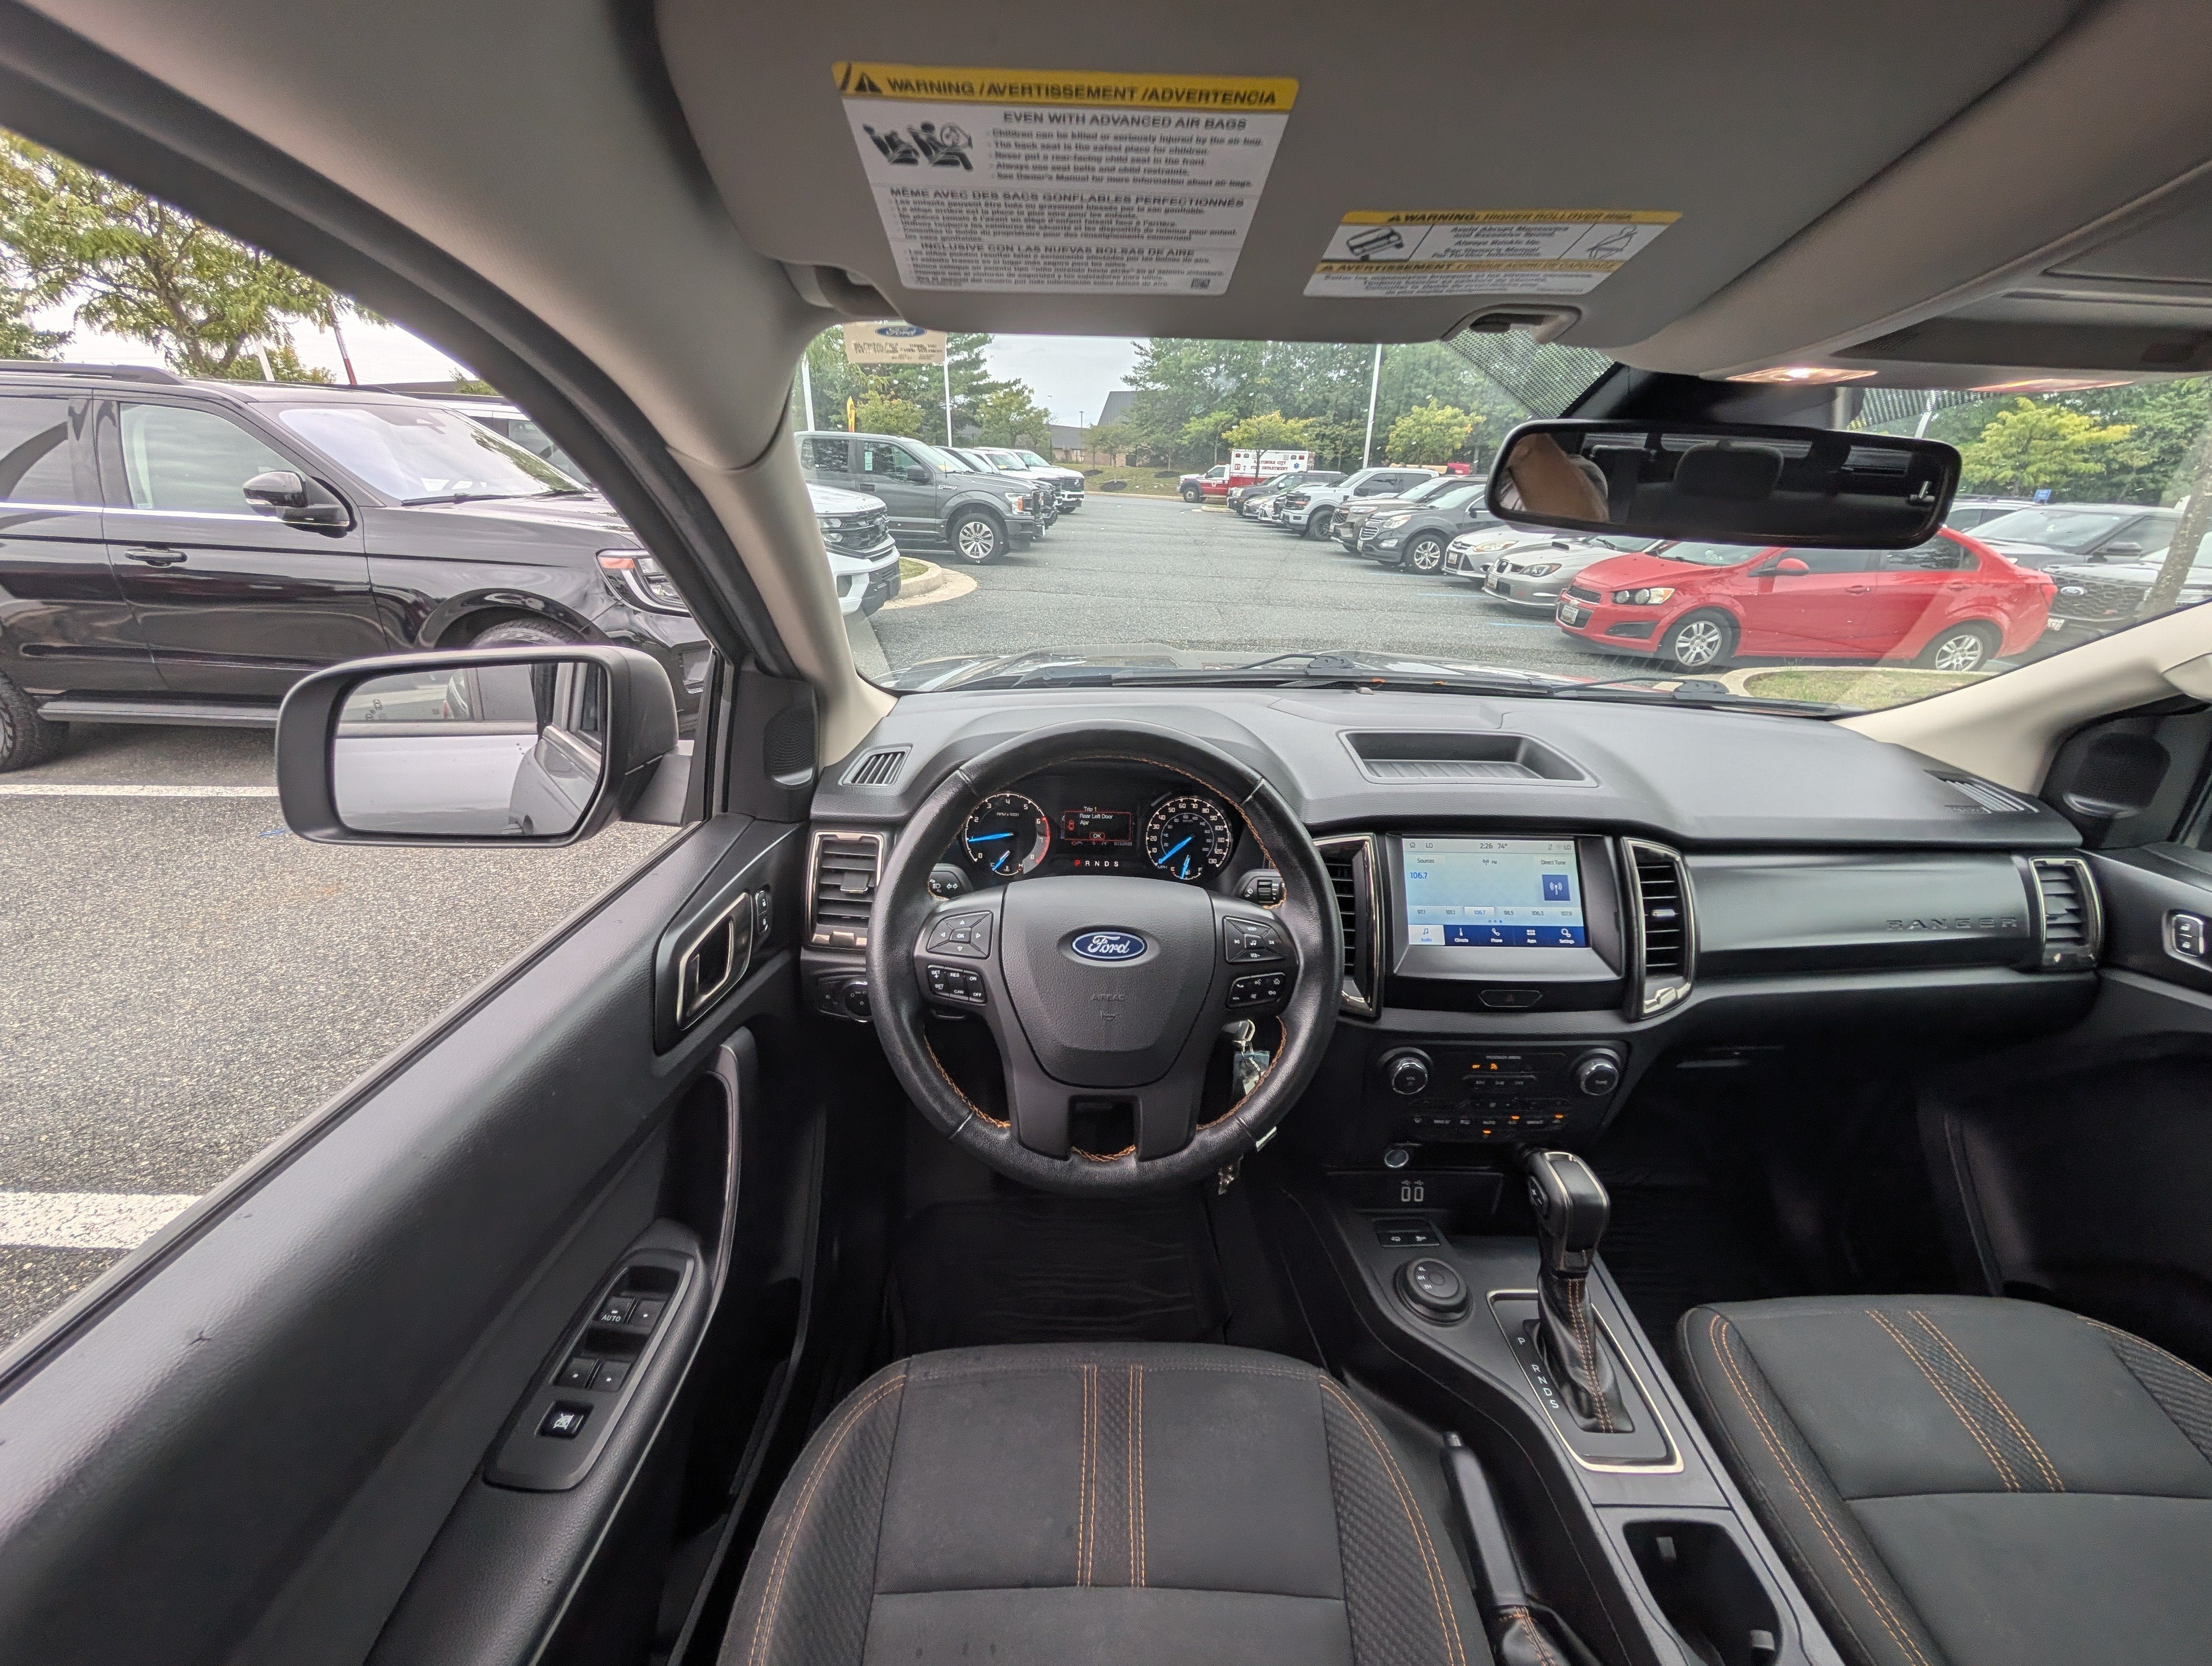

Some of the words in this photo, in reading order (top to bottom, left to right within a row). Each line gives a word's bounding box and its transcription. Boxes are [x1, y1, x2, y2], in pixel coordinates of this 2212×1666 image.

[887, 77, 974, 96] WARNING
[1004, 111, 1044, 124] EVEN
[1048, 112, 1085, 125] WITH
[1090, 113, 1172, 129] ADVANCED
[1175, 116, 1200, 129] AIR
[1205, 117, 1247, 131] BAGS
[1886, 917, 2018, 931] RANGER
[1088, 935, 1131, 954] Ford
[1091, 993, 1127, 1002] AIRBAG
[601, 1314, 621, 1322] AUTO
[1531, 1364, 1541, 1373] R
[1537, 1376, 1548, 1385] N
[1543, 1387, 1552, 1396] D
[1549, 1399, 1559, 1408] S
